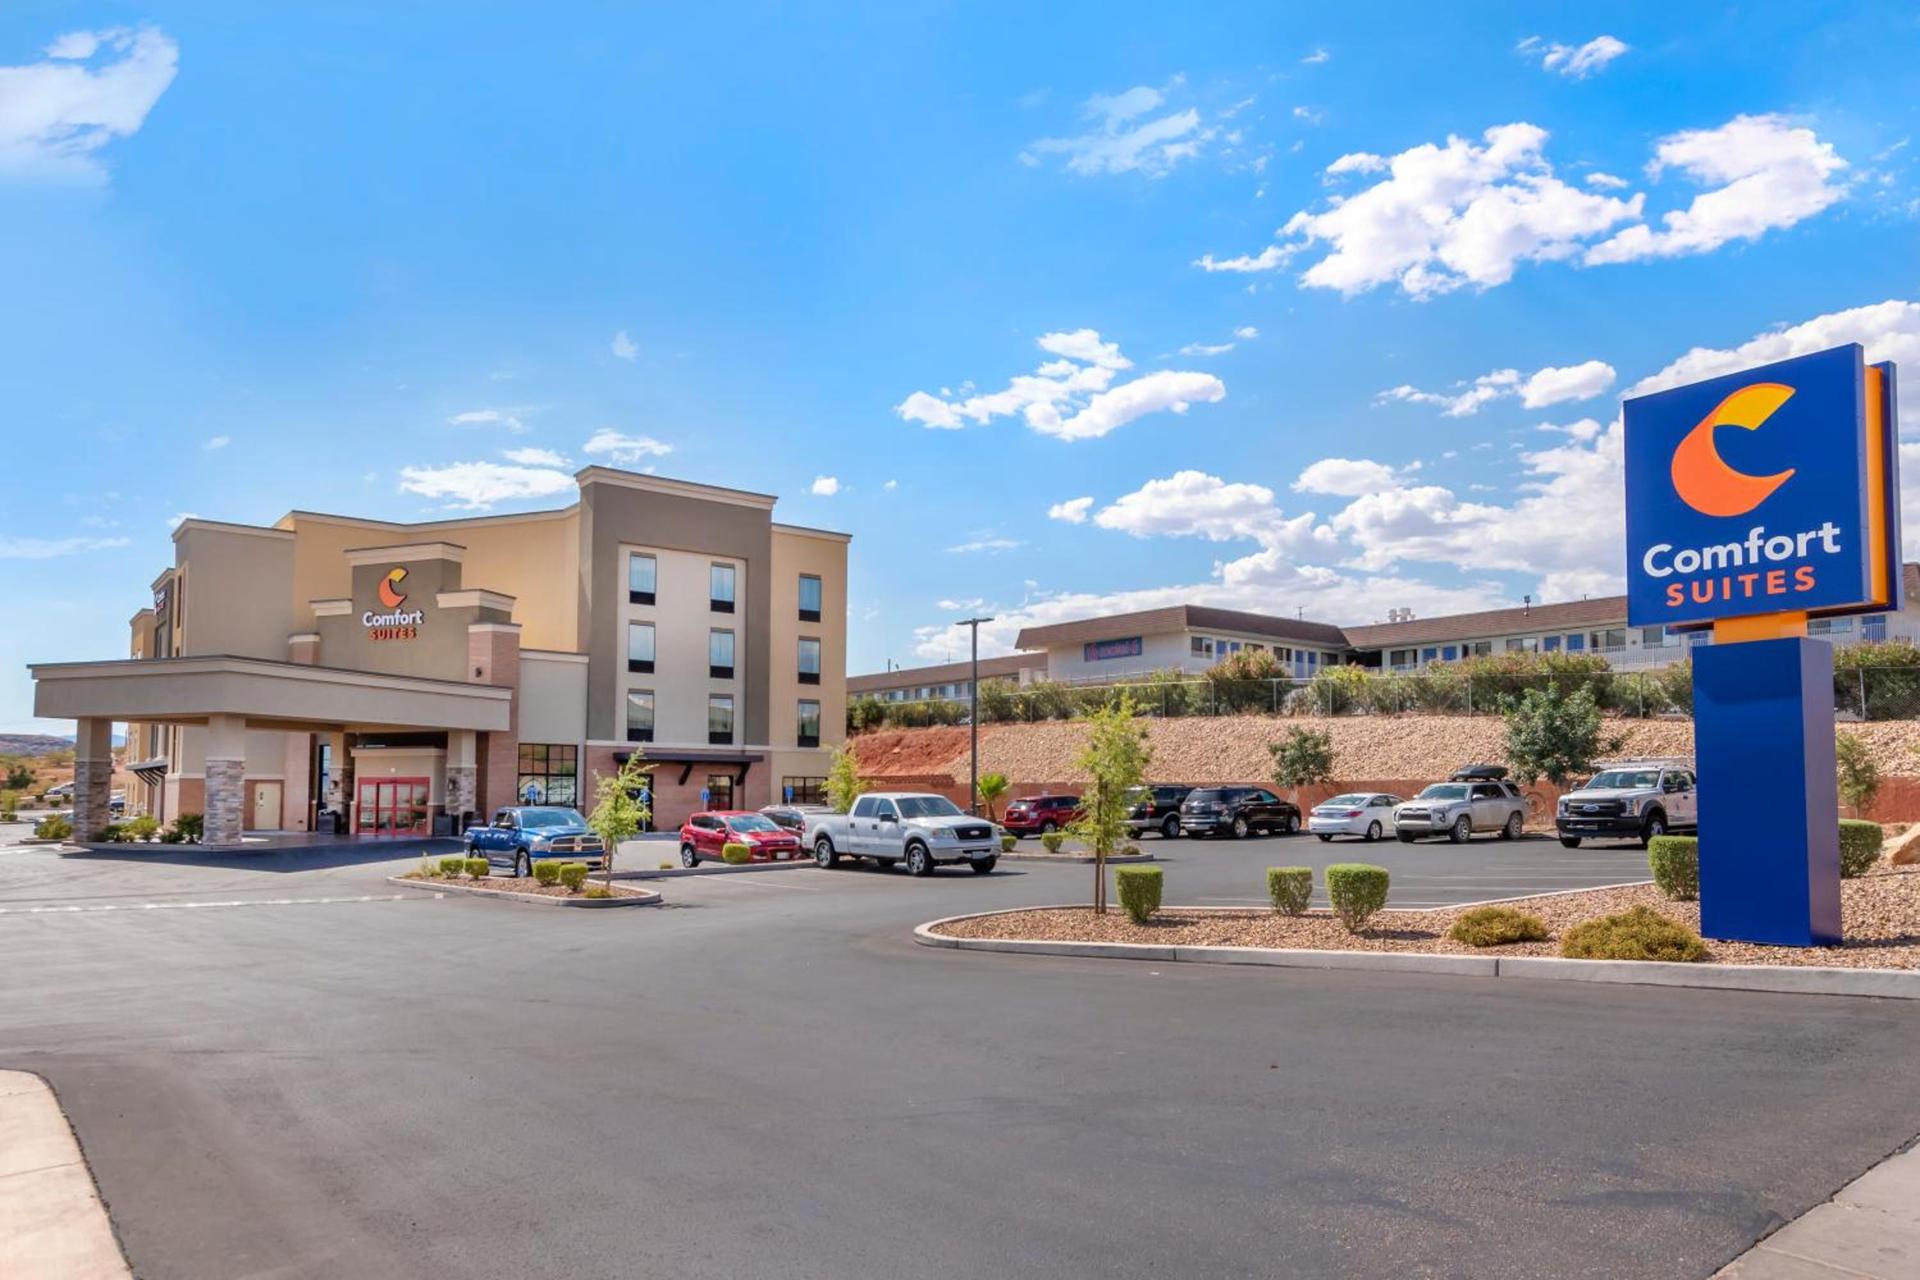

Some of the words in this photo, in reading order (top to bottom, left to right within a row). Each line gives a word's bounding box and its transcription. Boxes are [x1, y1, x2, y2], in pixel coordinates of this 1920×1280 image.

[1643, 522, 1841, 578] Comfort
[1666, 566, 1816, 607] SUITES
[362, 609, 423, 627] Comfort
[368, 627, 416, 640] SUITES
